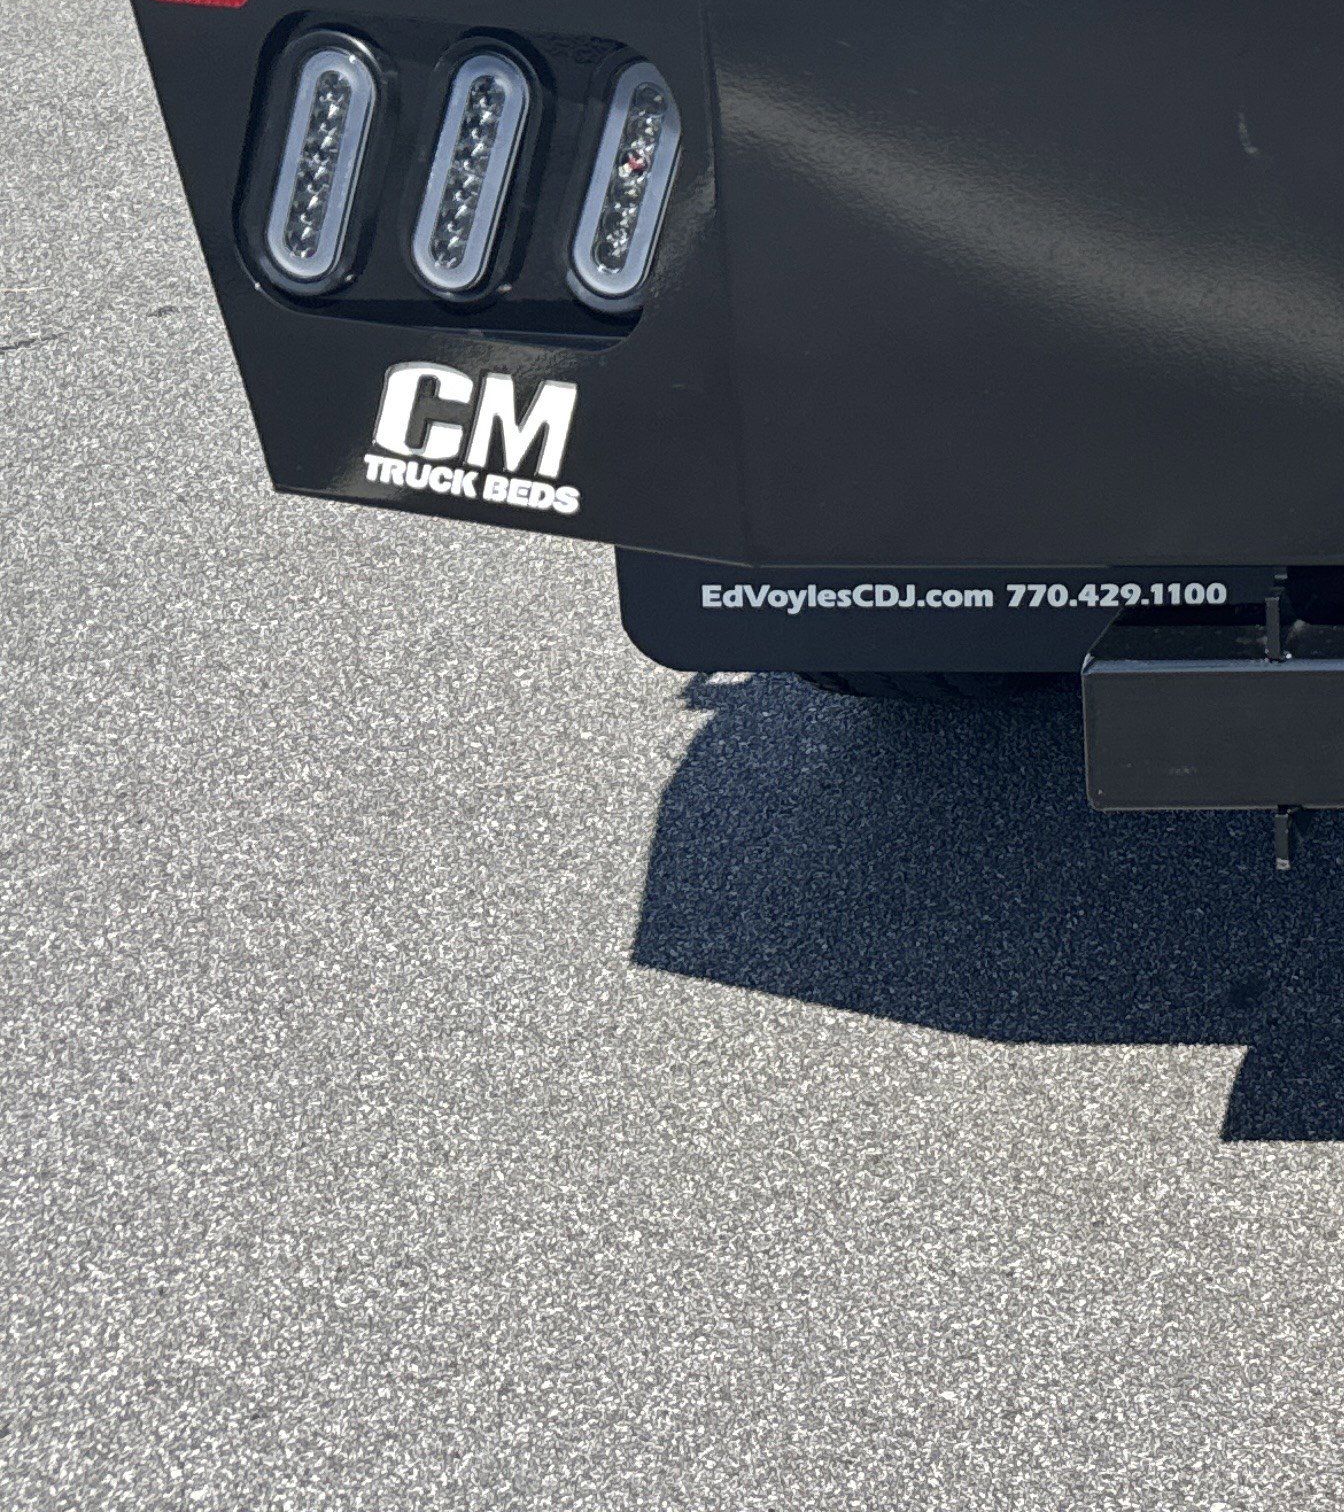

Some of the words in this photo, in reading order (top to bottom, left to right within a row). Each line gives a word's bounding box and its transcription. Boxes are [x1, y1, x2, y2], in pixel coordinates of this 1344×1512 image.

[373, 361, 578, 479] CM
[364, 453, 480, 499] TRUCK
[482, 473, 581, 515] BEDS
[701, 584, 994, 614] EdVoylesCDJ.com
[1006, 582, 1227, 608] 770.429.1100
